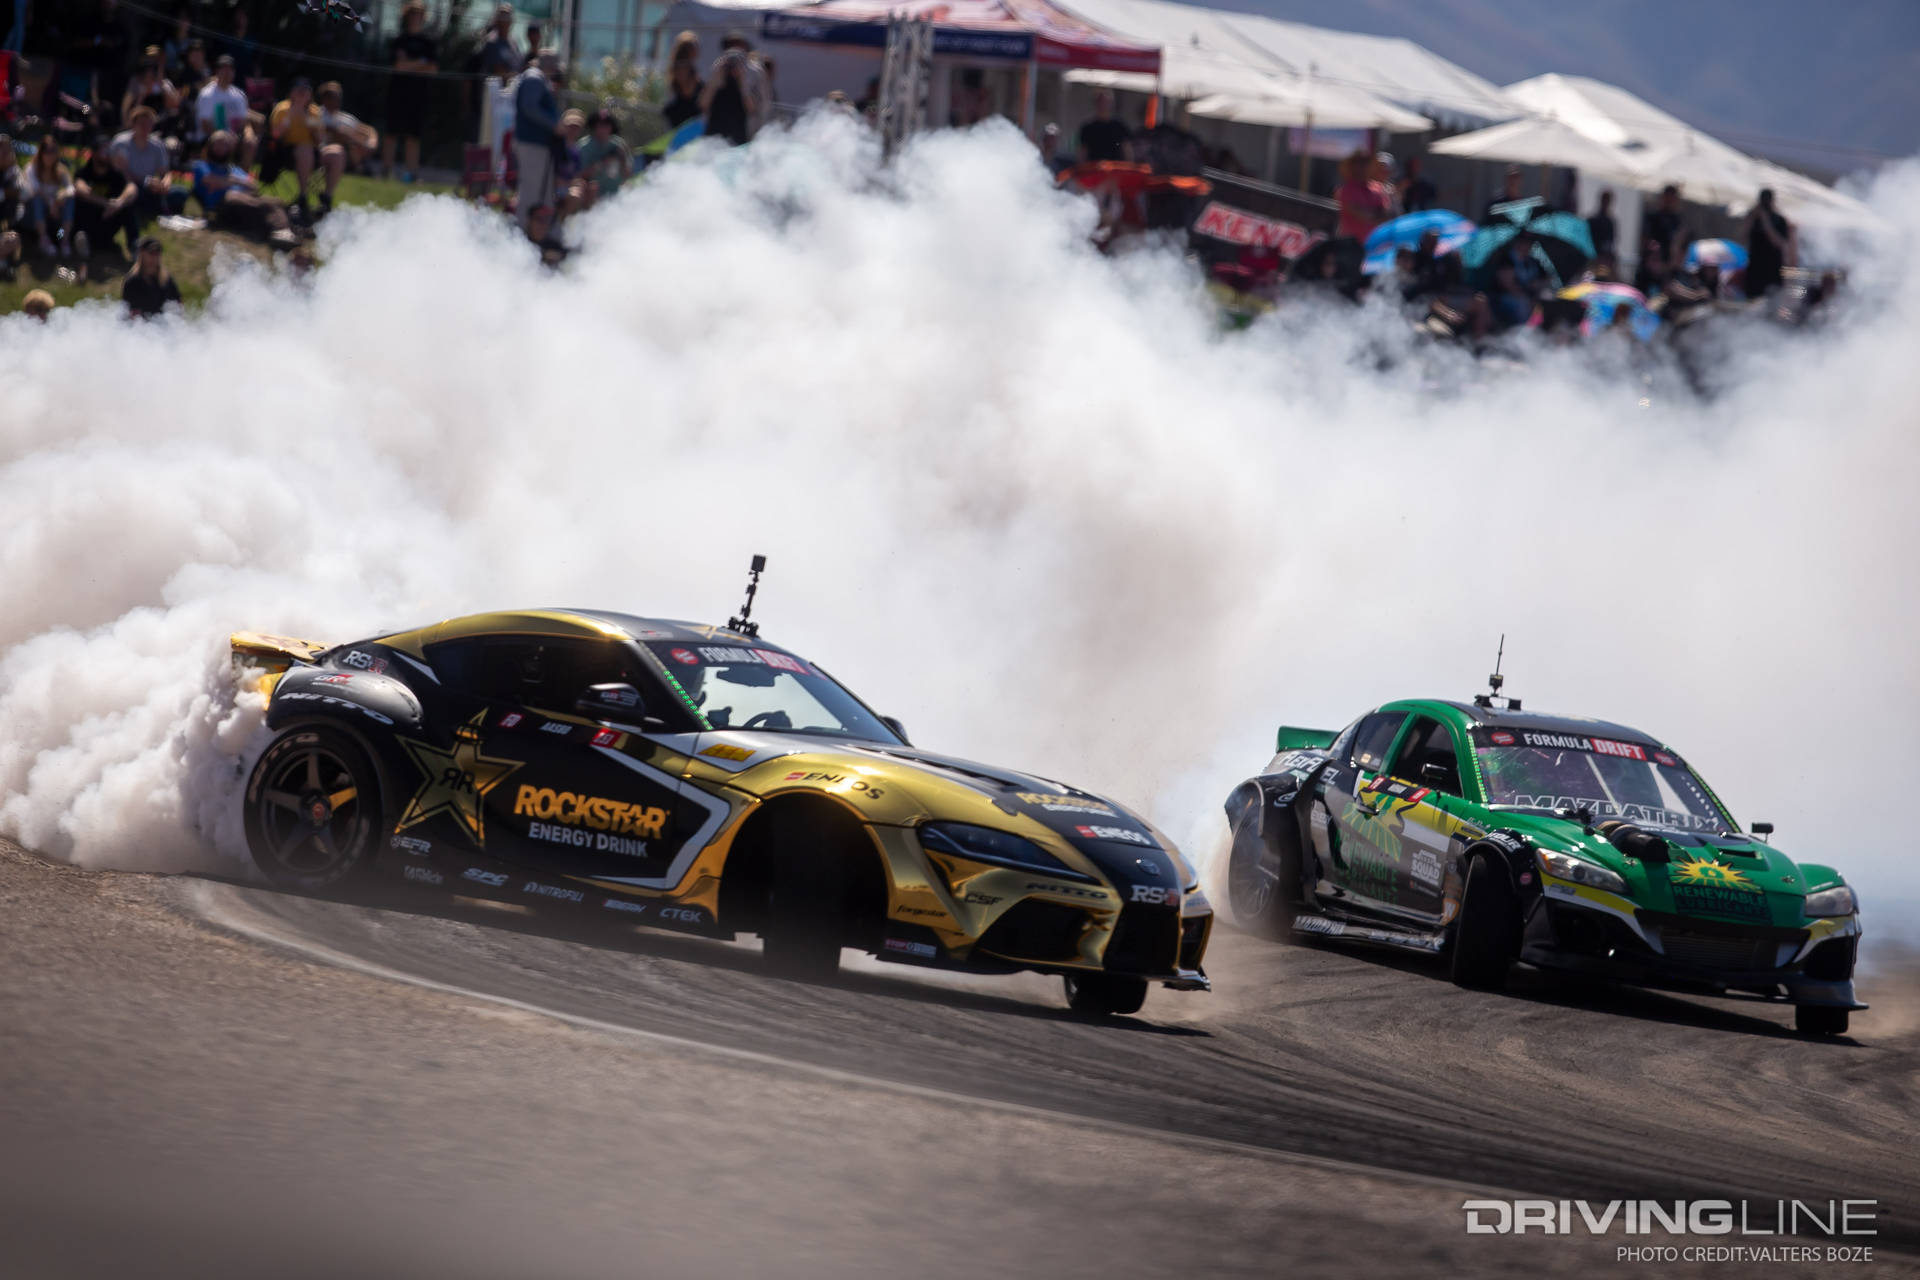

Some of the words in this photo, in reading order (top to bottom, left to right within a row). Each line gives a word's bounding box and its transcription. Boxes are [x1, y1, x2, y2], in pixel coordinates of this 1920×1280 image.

[1523, 733, 1593, 751] FORMULA
[1593, 738, 1646, 761] DRIFT
[803, 772, 885, 800] ENOS
[513, 784, 667, 840] ROCKSTAR
[1514, 794, 1720, 834] MAZDATRIX
[528, 821, 594, 848] ENERGY
[596, 832, 648, 859] DRINK
[1025, 882, 1109, 900] NITTO
[1673, 886, 1767, 908] RENEWABLE
[659, 908, 702, 922] CTEK
